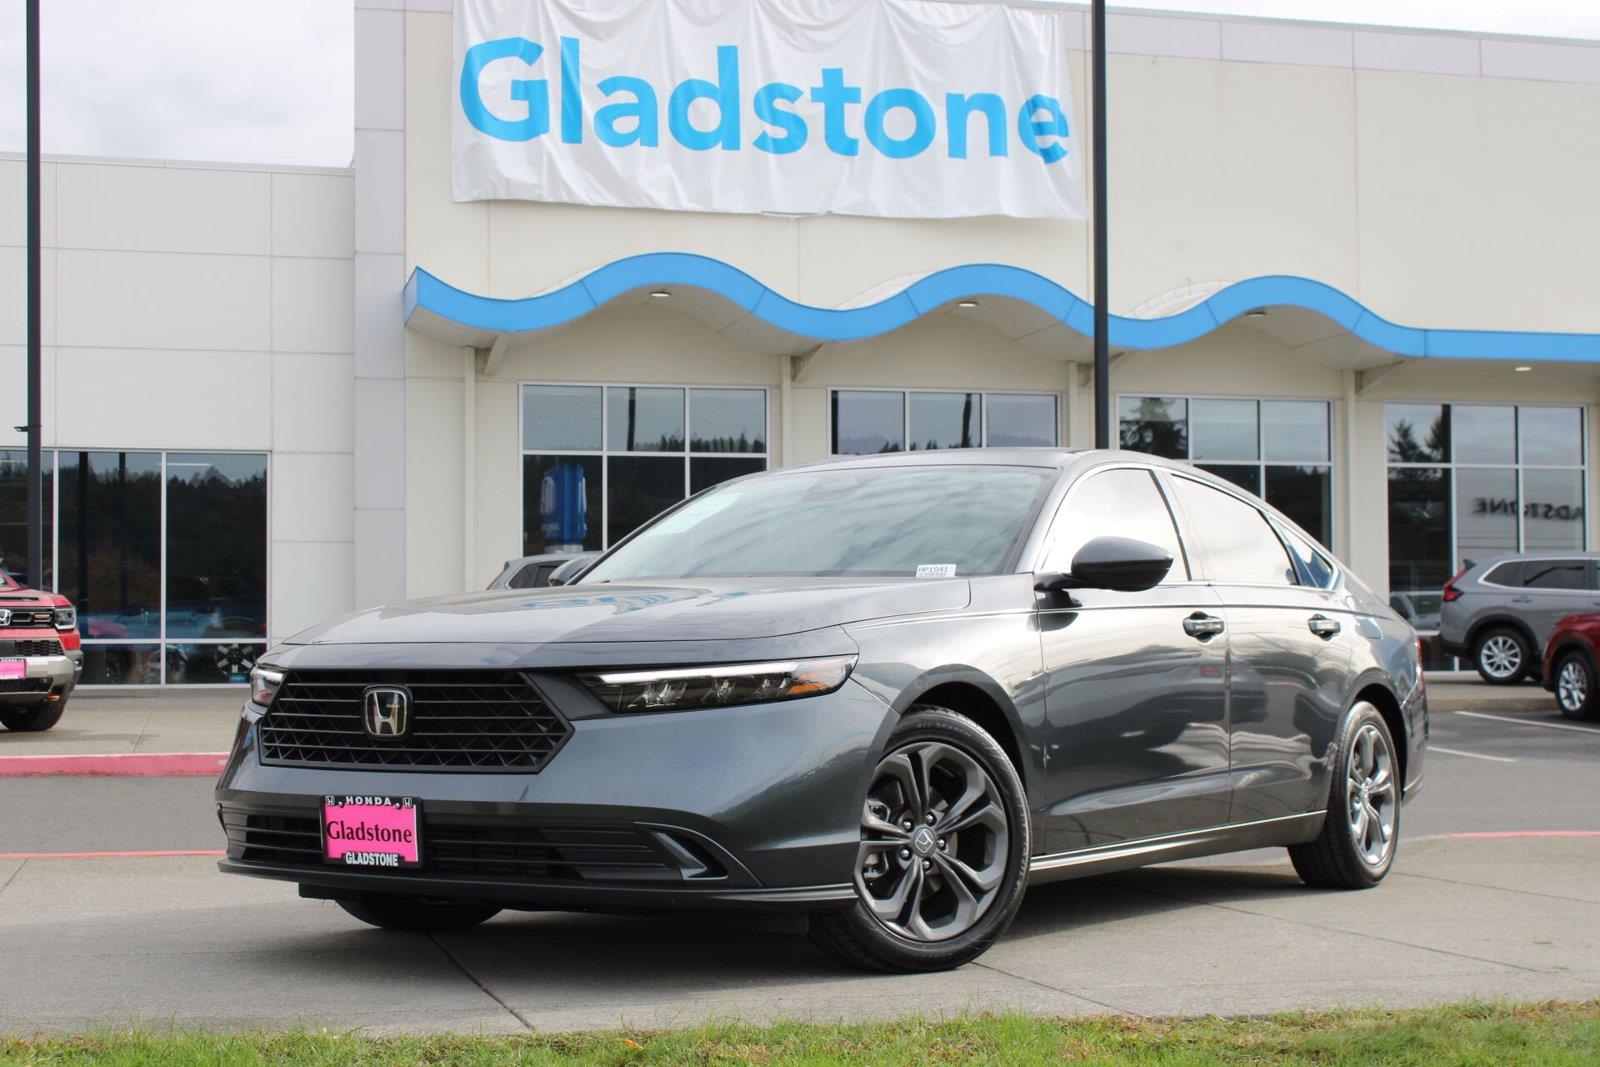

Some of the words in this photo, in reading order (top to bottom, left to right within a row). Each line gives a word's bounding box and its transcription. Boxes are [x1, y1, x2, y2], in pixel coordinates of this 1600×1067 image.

[459, 36, 1070, 165] Gladstone
[345, 796, 392, 806] HONDA
[327, 820, 412, 843] Gladstone
[345, 851, 399, 867] GLADSTONE
